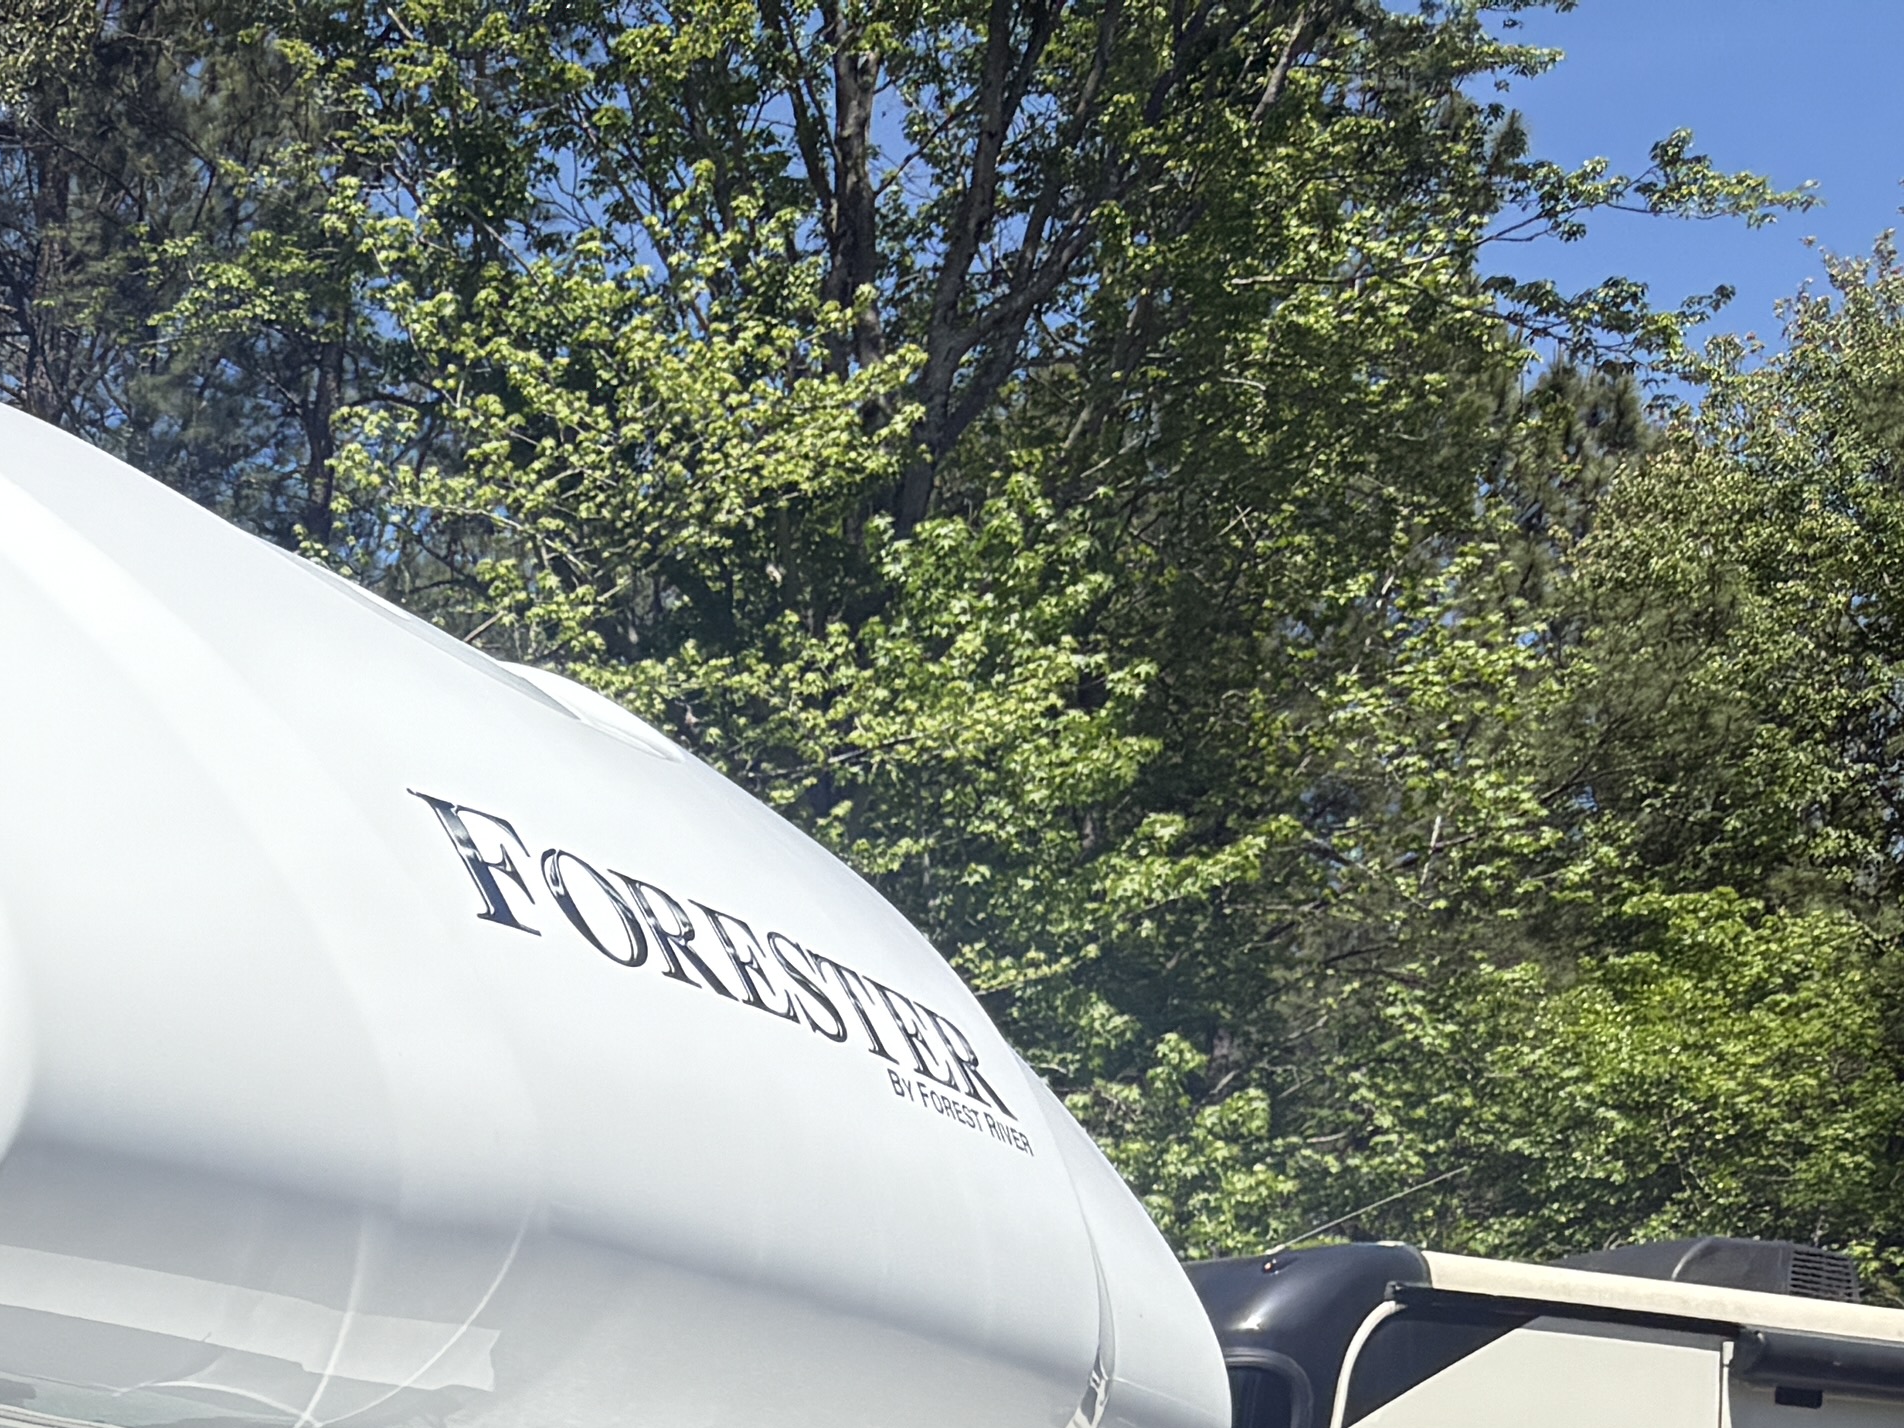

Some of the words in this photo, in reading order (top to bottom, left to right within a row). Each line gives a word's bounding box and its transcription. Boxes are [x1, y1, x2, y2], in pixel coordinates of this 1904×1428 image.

[406, 787, 1019, 1121] FORESTER
[887, 1068, 914, 1102] BY
[916, 1081, 983, 1132] FOREST
[983, 1111, 1034, 1157] RIVER
